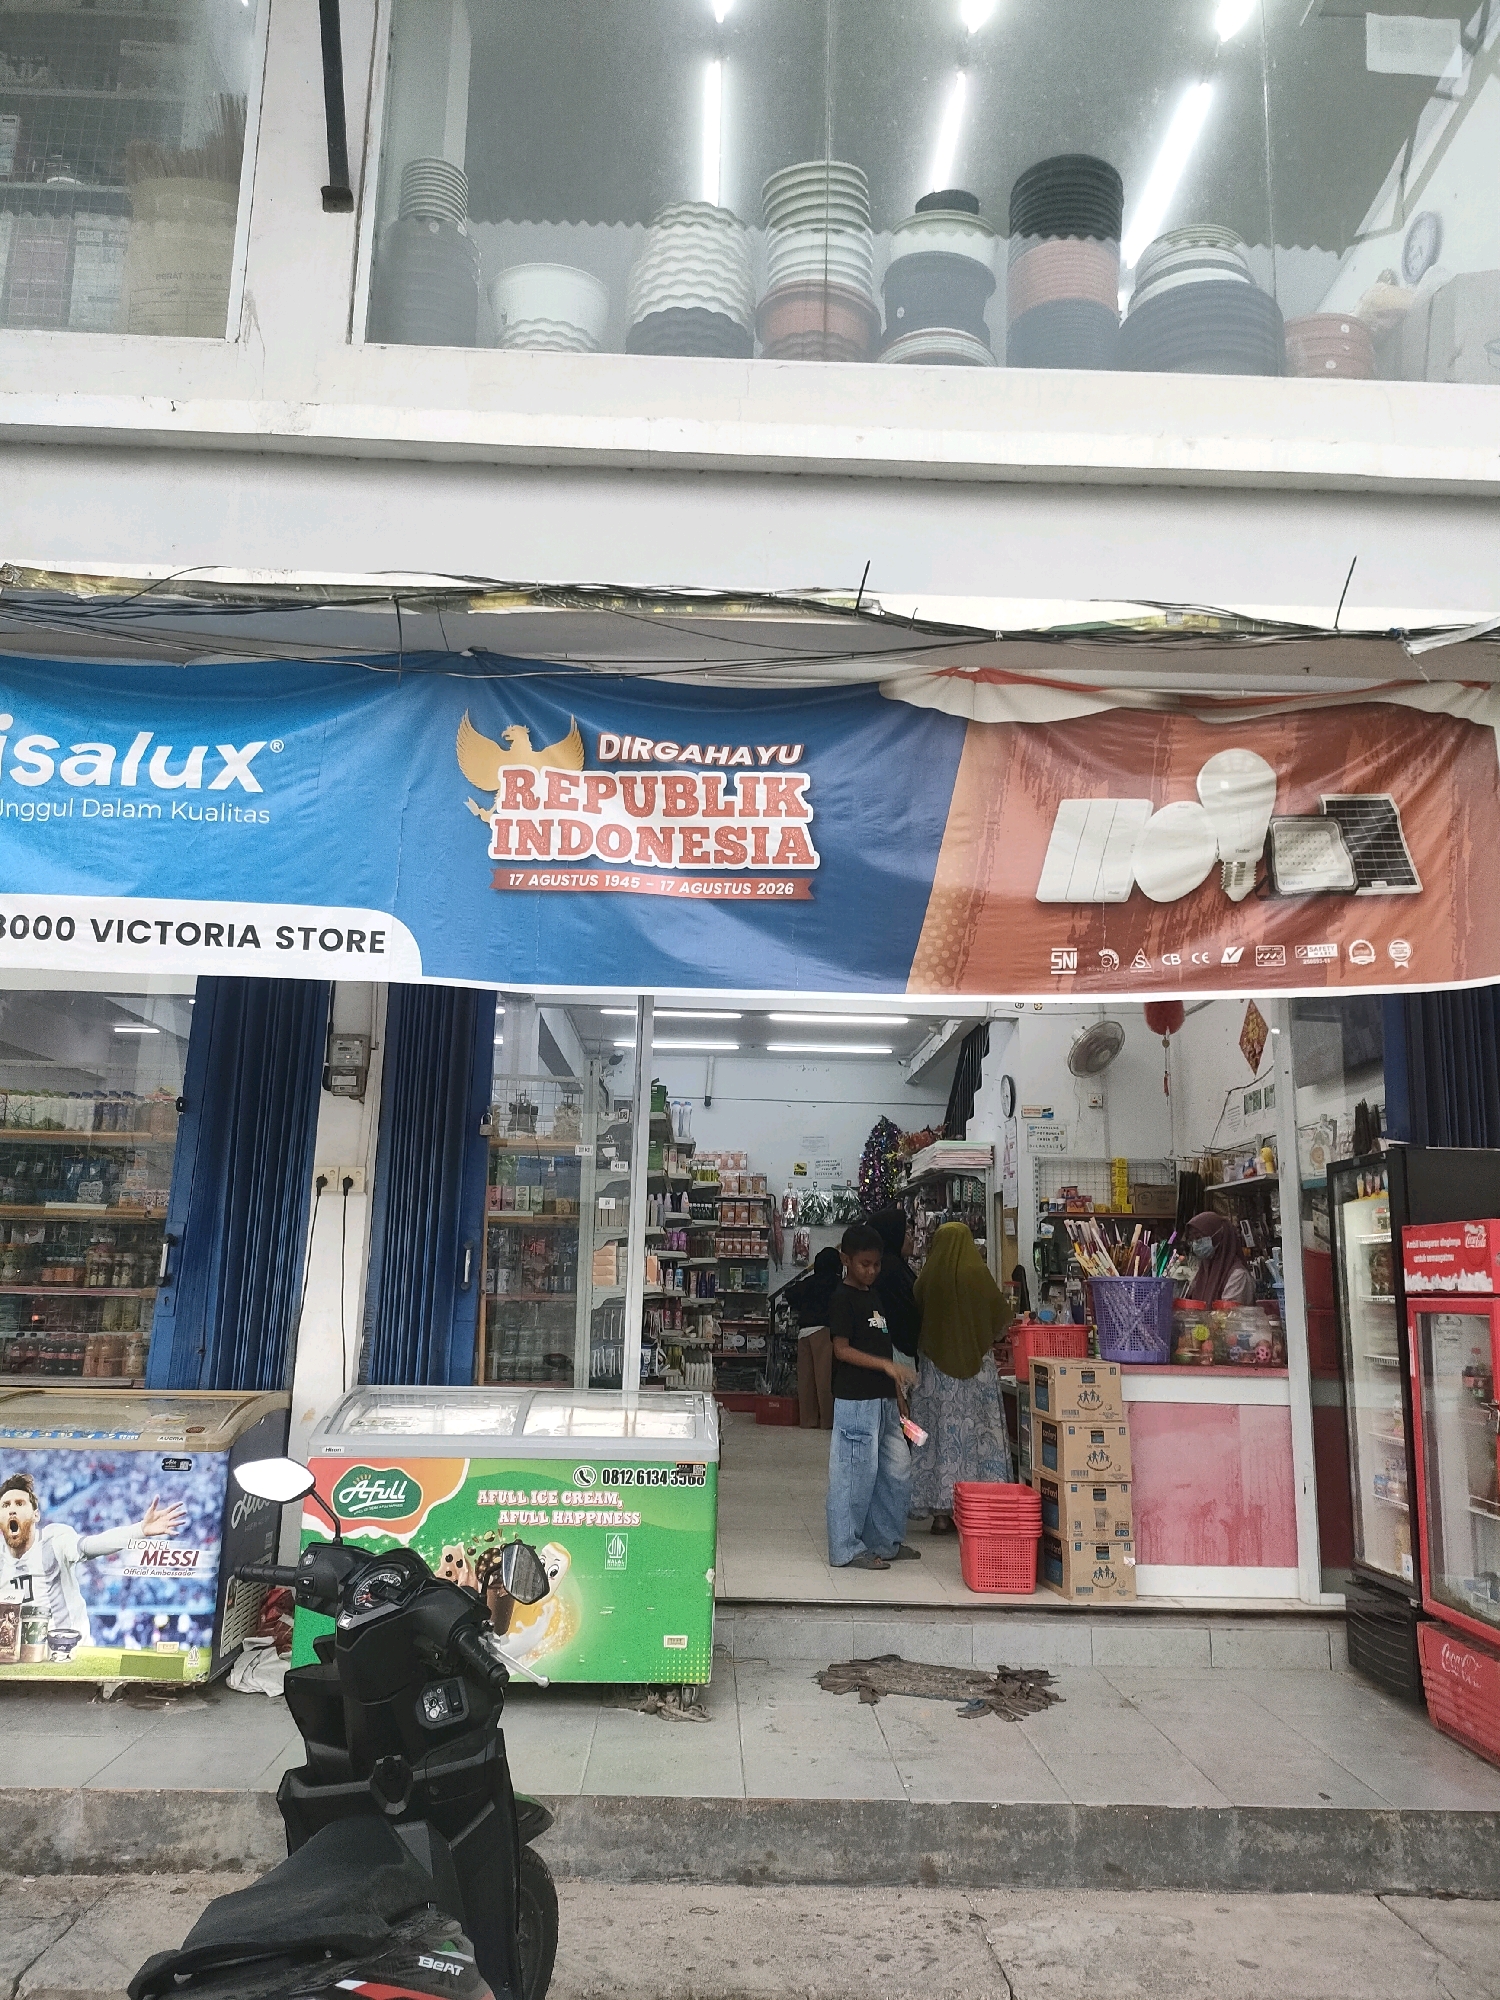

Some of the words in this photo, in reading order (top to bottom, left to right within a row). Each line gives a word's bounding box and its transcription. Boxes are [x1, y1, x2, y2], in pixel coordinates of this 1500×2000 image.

[600, 733, 804, 767] DIRGAHAYU
[501, 769, 809, 818] REPUBLIK
[0, 798, 74, 822] nggul
[82, 798, 162, 820] Dalam
[171, 801, 271, 824] Kualitas
[493, 818, 815, 865] INDONESIA
[509, 873, 525, 886] 17
[528, 874, 599, 887] AGUSTUS
[605, 875, 641, 888] 1945
[660, 880, 675, 892] 17
[679, 882, 752, 895] AGUSTUS
[757, 882, 795, 895] 2026
[91, 918, 261, 949] VICTORIA
[276, 927, 386, 953] STORE
[1308, 945, 1335, 953] SAFETY
[1051, 951, 1078, 970] SNI
[1161, 954, 1181, 965] CB
[602, 1469, 633, 1485] 0812
[636, 1469, 668, 1485] 6134
[477, 1490, 529, 1505] AFULL
[531, 1490, 559, 1505] ICE
[560, 1490, 624, 1509] CREAM,
[498, 1510, 550, 1526] AFULL
[552, 1510, 642, 1526] HAPPINESS
[127, 1538, 170, 1551] LIONEL
[140, 1550, 200, 1567] MESSI
[123, 1568, 149, 1576] Official
